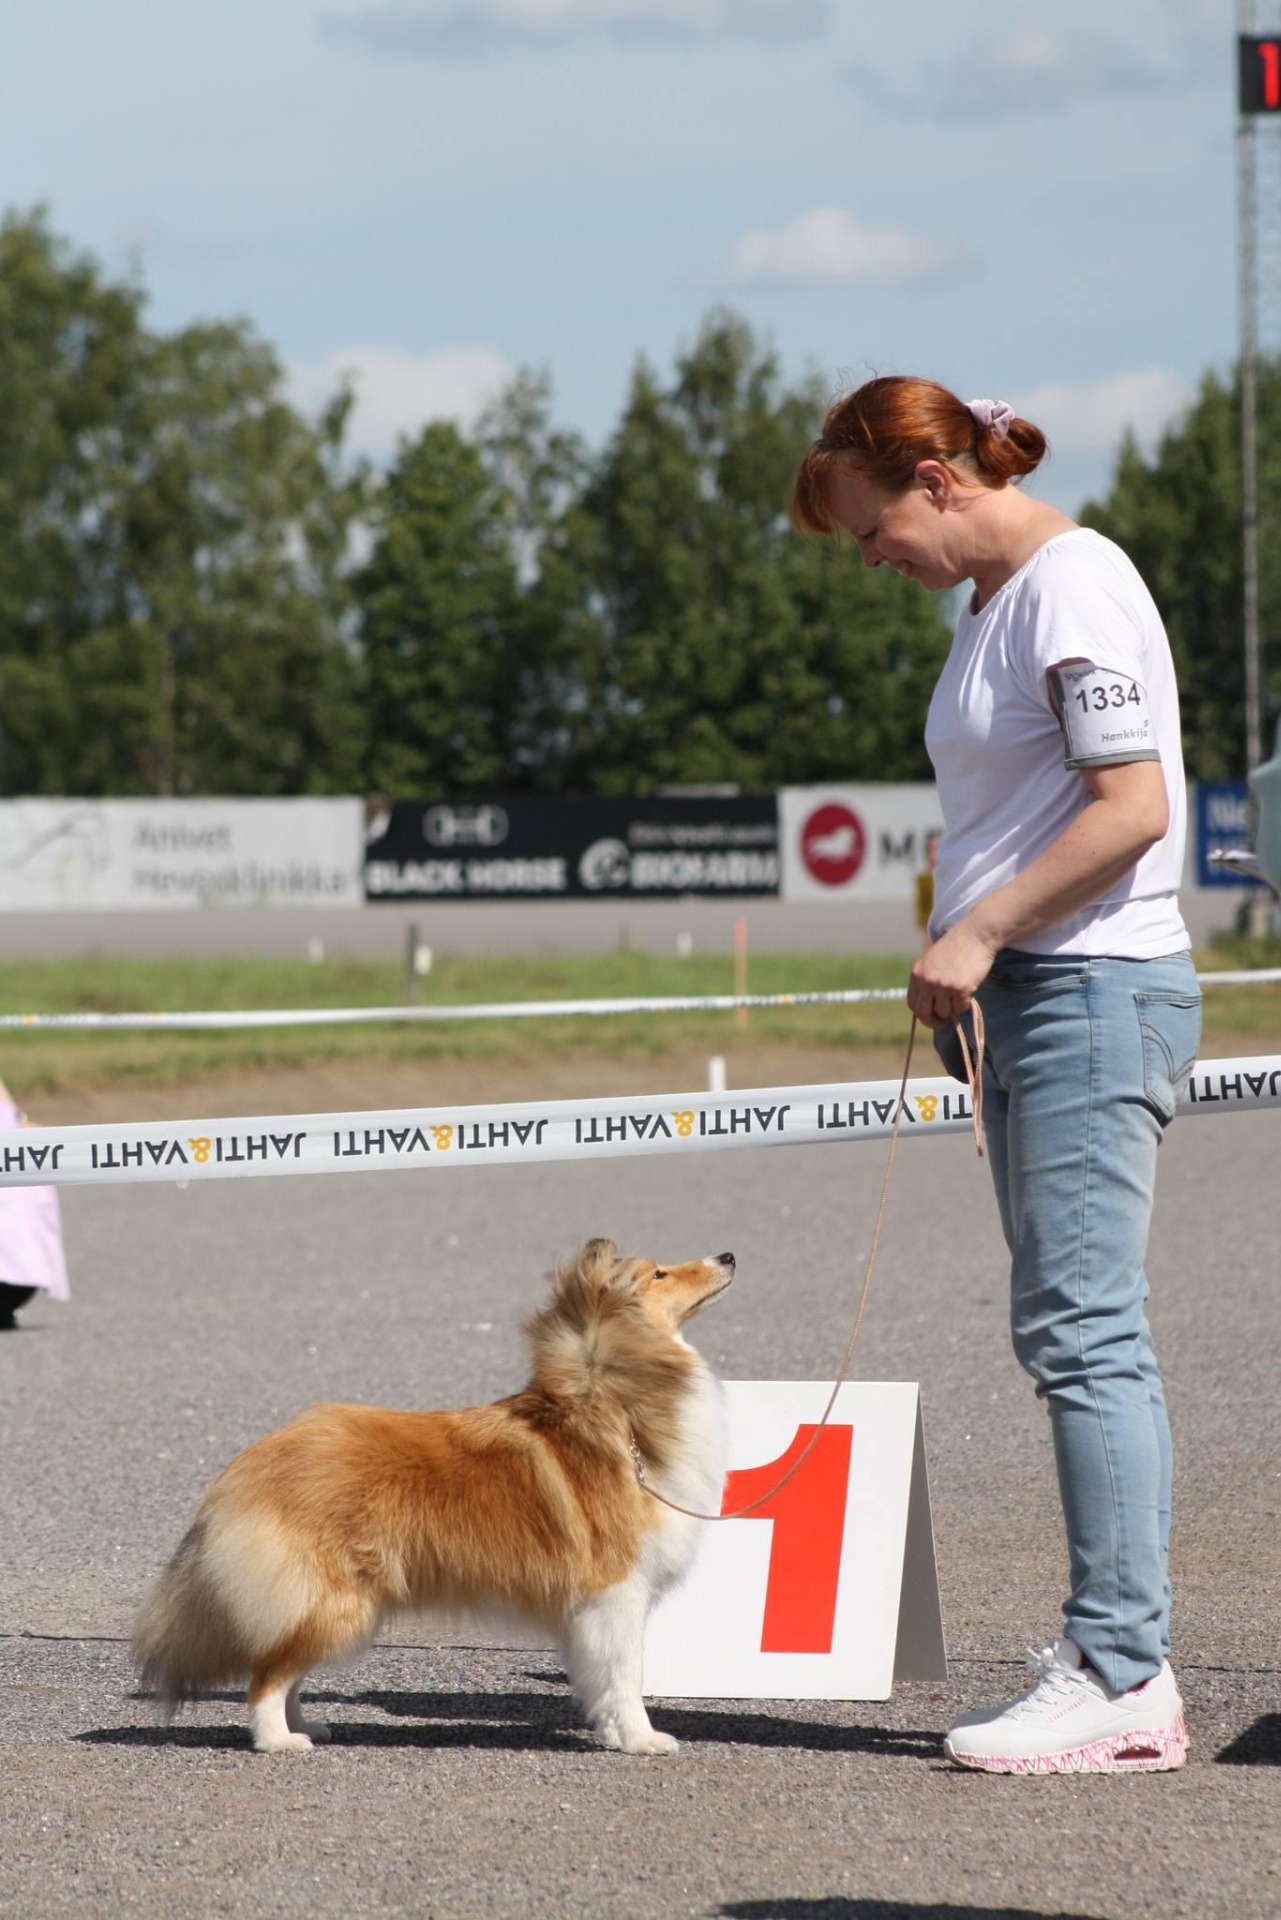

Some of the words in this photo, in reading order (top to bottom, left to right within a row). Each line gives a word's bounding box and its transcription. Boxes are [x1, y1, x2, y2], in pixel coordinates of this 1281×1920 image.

[1076, 683, 1142, 713] 1334
[1101, 728, 1149, 743] Hankkija
[367, 860, 465, 893] BLACK
[466, 857, 567, 891] HORSE
[817, 1093, 974, 1129] TI&VAHTI
[720, 1424, 853, 1653] 1
